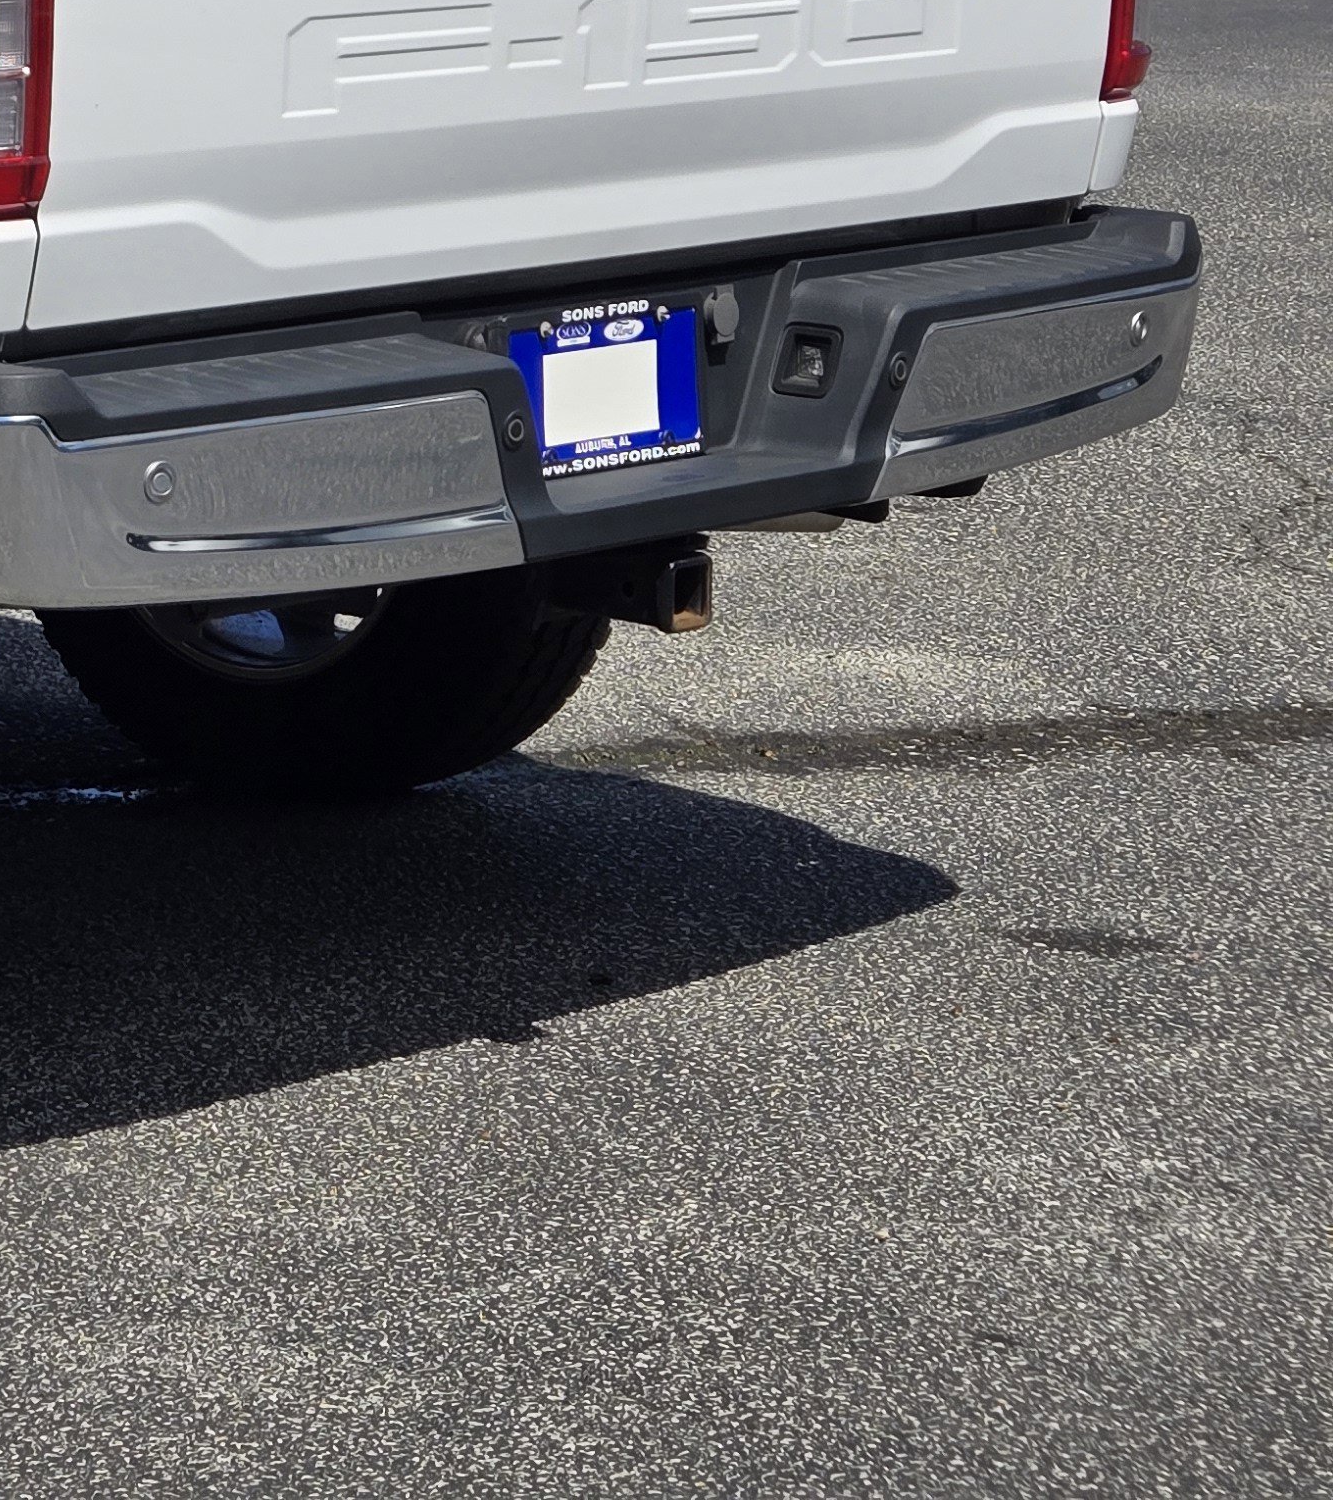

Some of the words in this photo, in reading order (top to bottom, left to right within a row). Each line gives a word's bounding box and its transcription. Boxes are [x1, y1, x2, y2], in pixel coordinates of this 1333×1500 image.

[562, 306, 604, 322] SONS
[608, 299, 650, 317] FORD
[611, 321, 635, 337] Ford
[619, 436, 631, 446] AL
[542, 441, 700, 476] ww.SONSFORD.com
